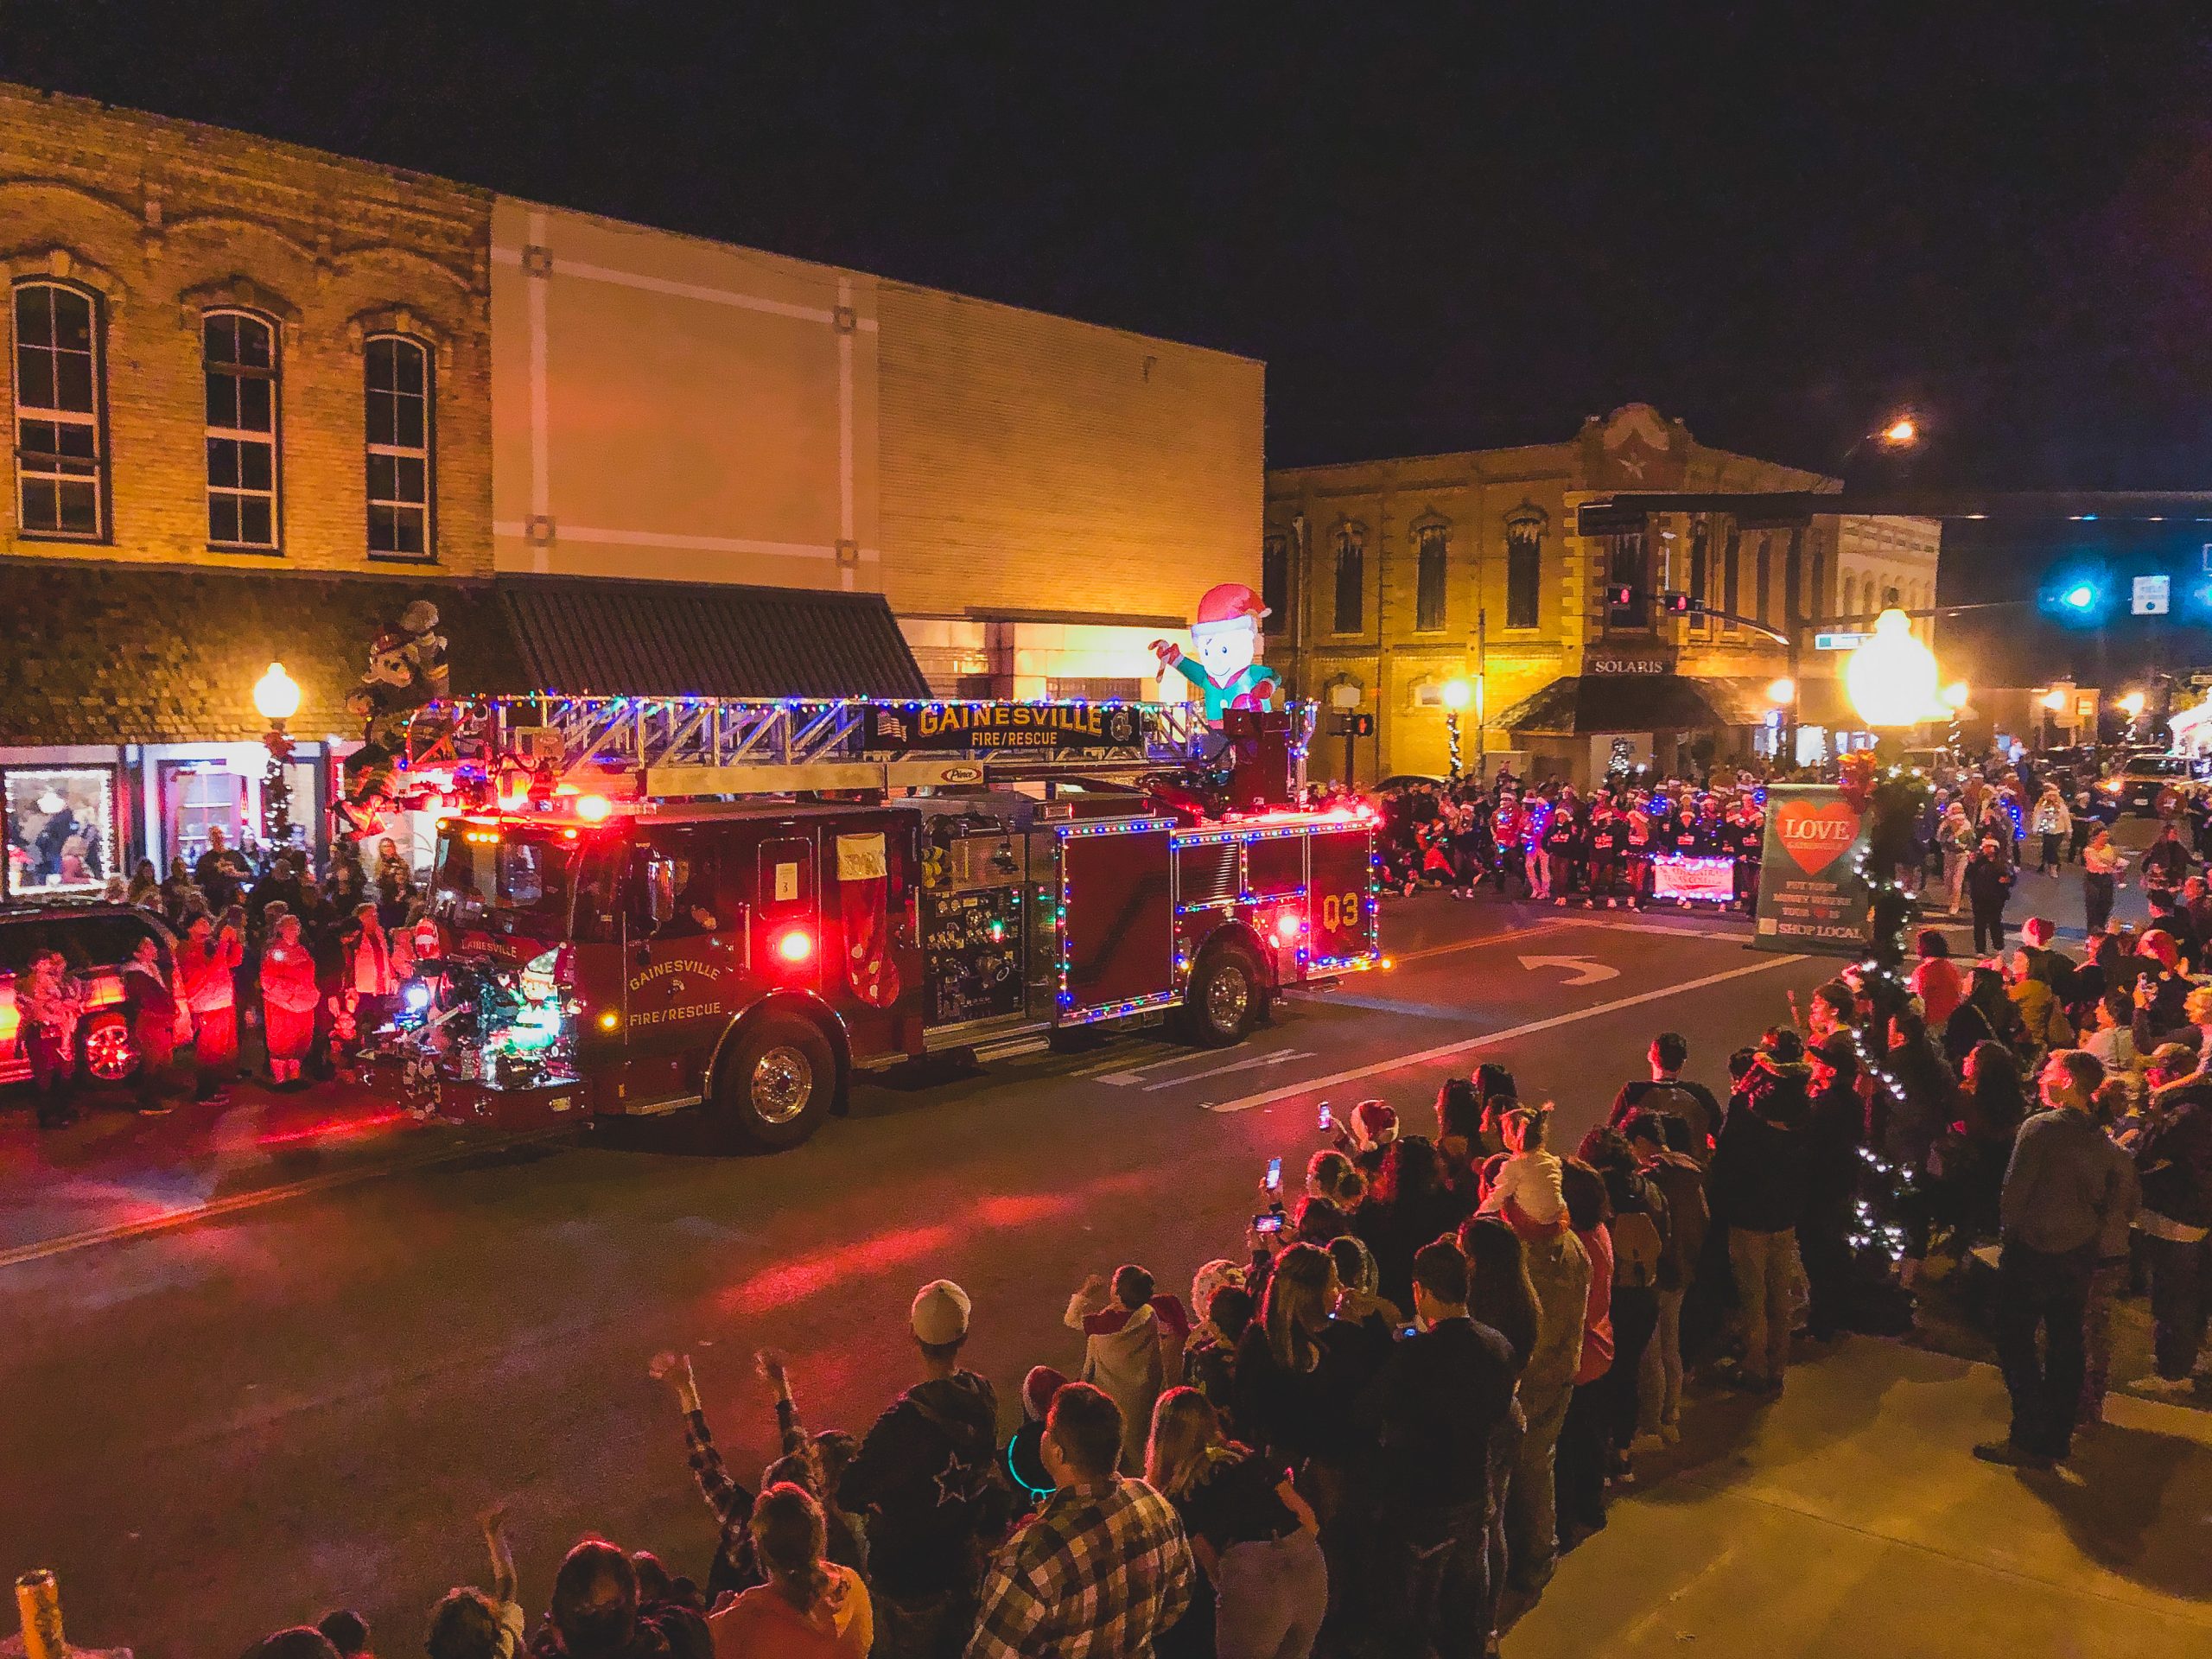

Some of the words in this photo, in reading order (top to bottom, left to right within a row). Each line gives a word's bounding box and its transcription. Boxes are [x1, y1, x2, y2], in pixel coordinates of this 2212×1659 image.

[1595, 660, 1663, 673] SOLARIS
[918, 706, 1103, 737] GAINESVILLE
[971, 732, 1057, 746] FIRE/RESCUE
[1783, 818, 1851, 841] LOVE
[1323, 892, 1358, 933] Q3
[1778, 923, 1815, 936] SHOP
[1816, 925, 1865, 939] LOCAL
[629, 959, 721, 991] GAINESVILLE
[629, 1002, 721, 1027] FIRE/RESCUE
